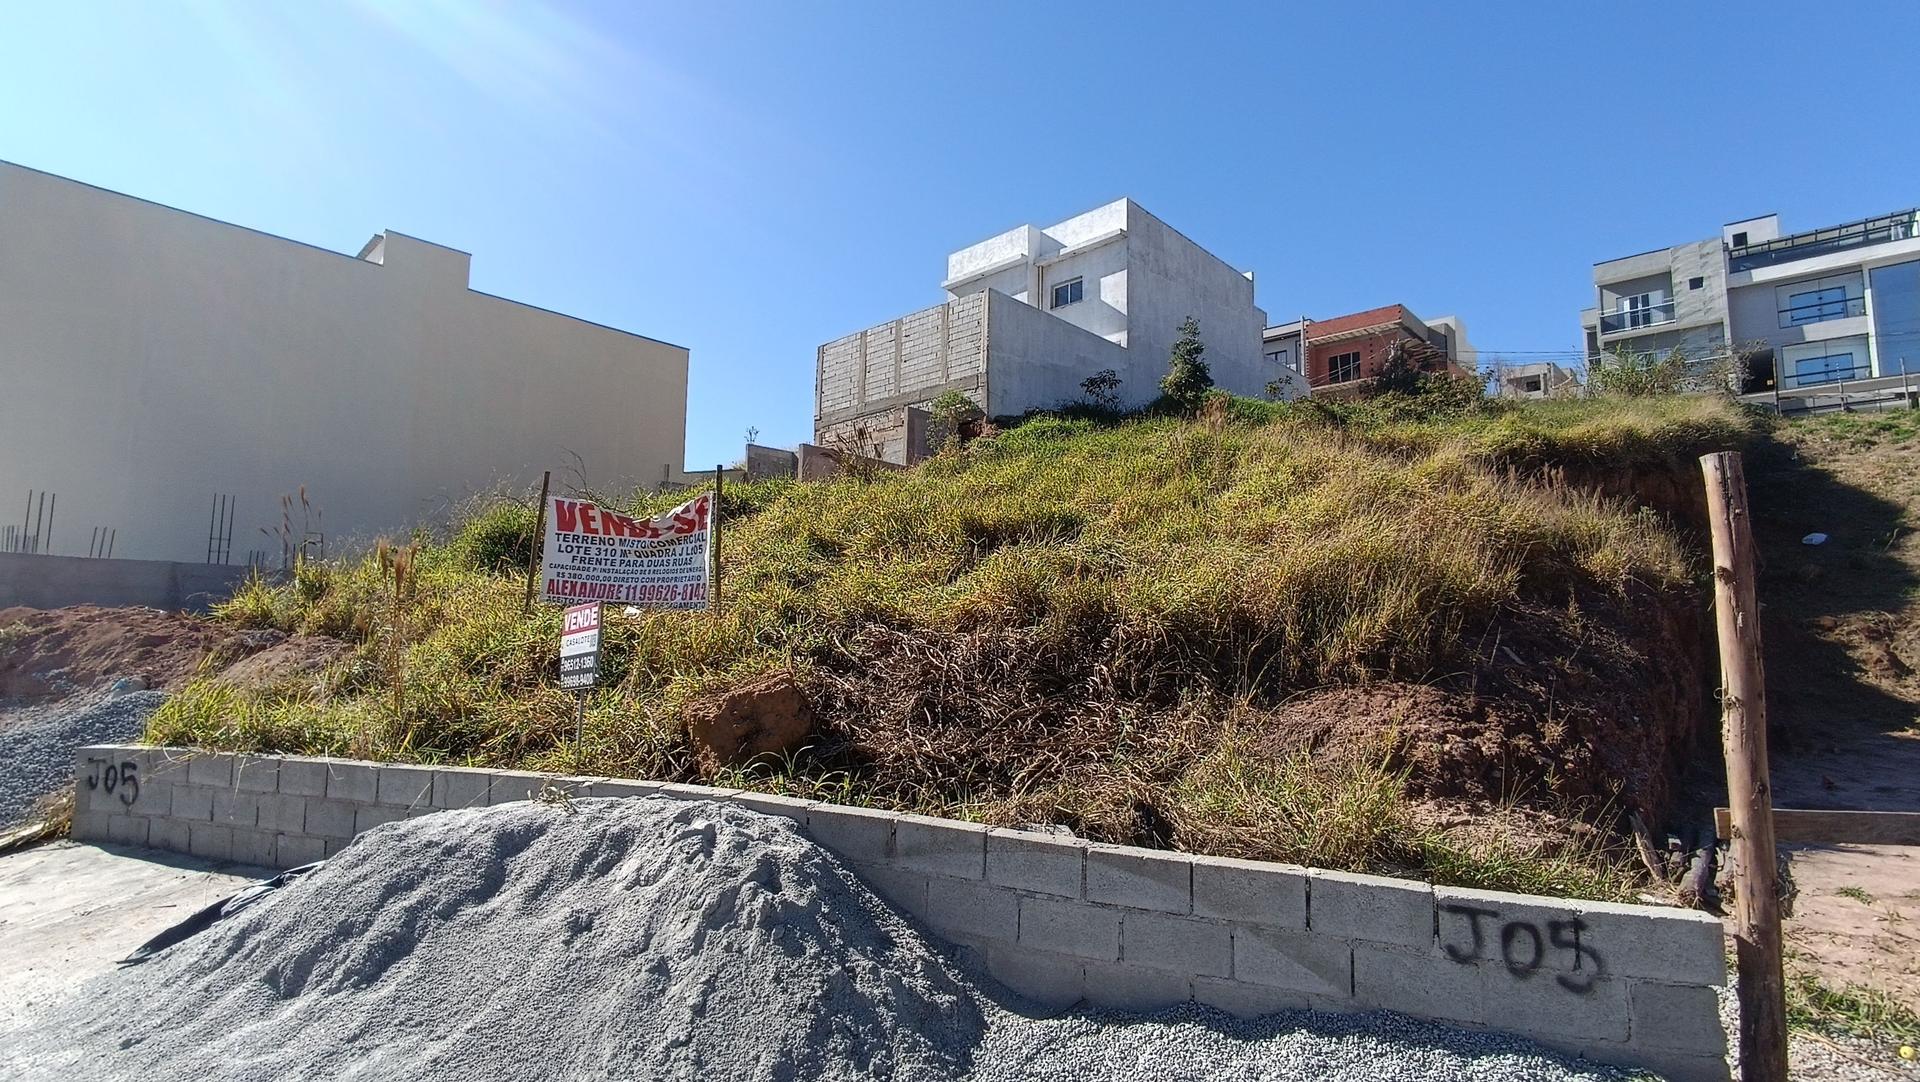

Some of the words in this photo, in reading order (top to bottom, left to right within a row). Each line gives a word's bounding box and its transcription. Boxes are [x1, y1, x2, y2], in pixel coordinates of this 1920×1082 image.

[555, 533, 615, 546] TERRENO
[558, 544, 592, 556] LOTE
[595, 547, 617, 558] 310
[634, 548, 677, 559] QUADRA
[679, 547, 685, 557] J
[571, 556, 616, 567] FRENTE
[619, 559, 644, 568] PARA
[646, 559, 671, 568] DUAS
[672, 557, 693, 567] RUAS
[549, 563, 591, 572] CAPACIDADE
[600, 567, 639, 576] INSTALAÇÃO
[640, 576, 656, 584] COM
[546, 578, 624, 600] ALEXANDRE
[546, 596, 575, 605] ACEITO
[564, 606, 598, 631] VENDE
